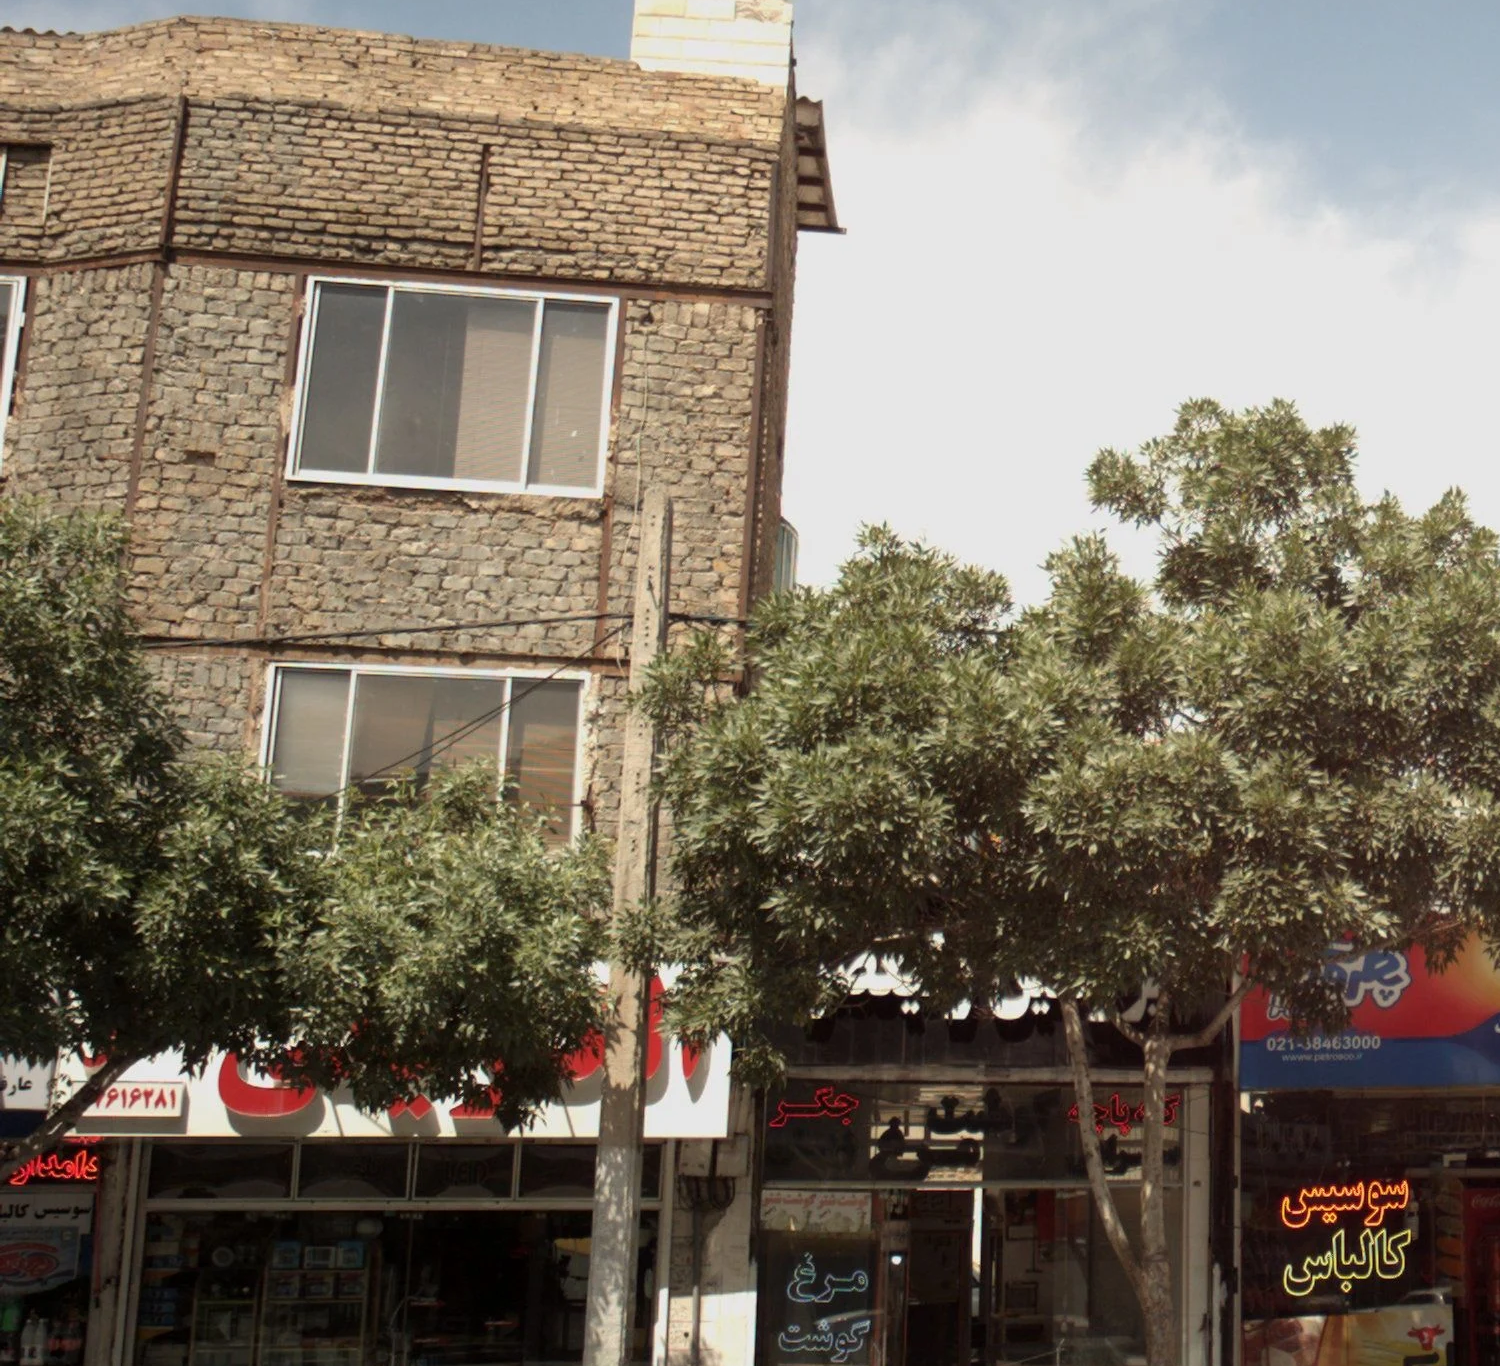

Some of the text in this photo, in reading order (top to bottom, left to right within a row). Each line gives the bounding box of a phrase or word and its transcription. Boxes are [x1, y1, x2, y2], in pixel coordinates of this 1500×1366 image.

[769, 1086, 860, 1128] جگر
[1133, 1094, 1182, 1126] که
[1281, 1179, 1410, 1229] سوسیس
[787, 1252, 869, 1303] مرغ
[1283, 1227, 1412, 1297] کالباس
[778, 1319, 871, 1363] گوشت
